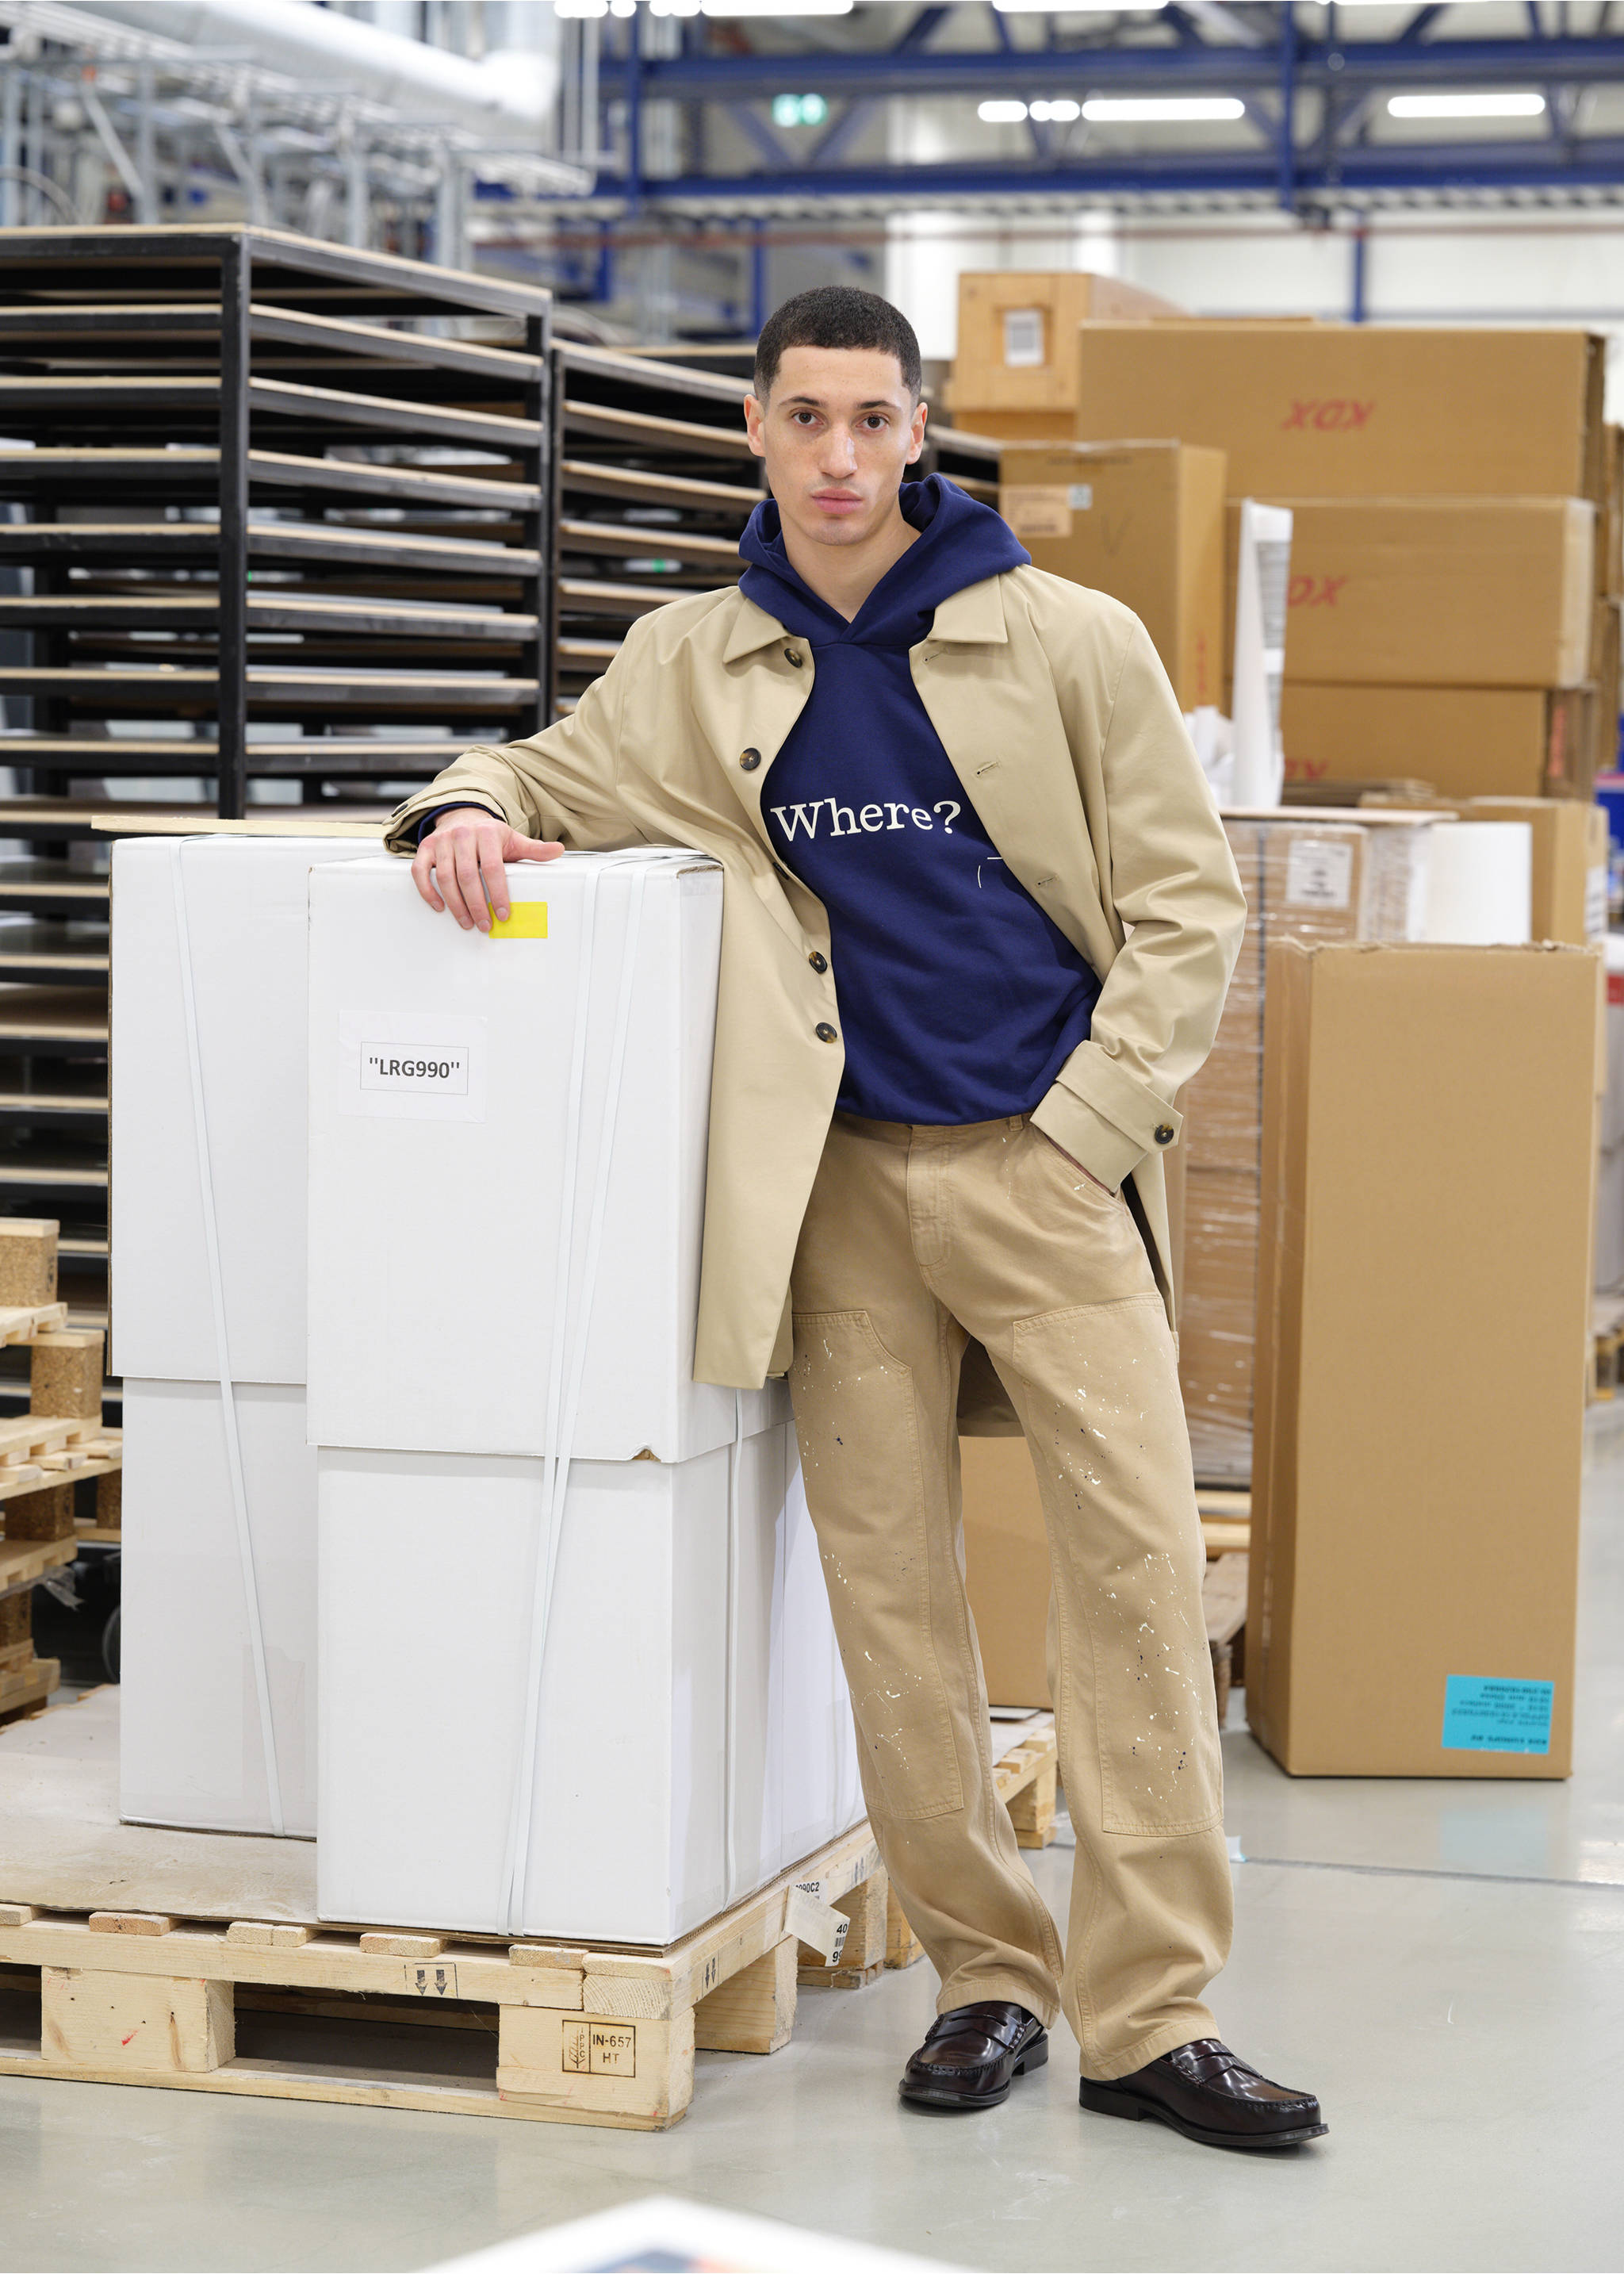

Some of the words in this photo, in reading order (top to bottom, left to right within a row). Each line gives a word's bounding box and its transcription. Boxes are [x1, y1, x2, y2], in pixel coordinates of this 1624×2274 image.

[770, 797, 961, 842] Where?
[837, 1923, 848, 1934] 40
[592, 2034, 632, 2048] IN-657
[603, 2052, 620, 2064] HT
